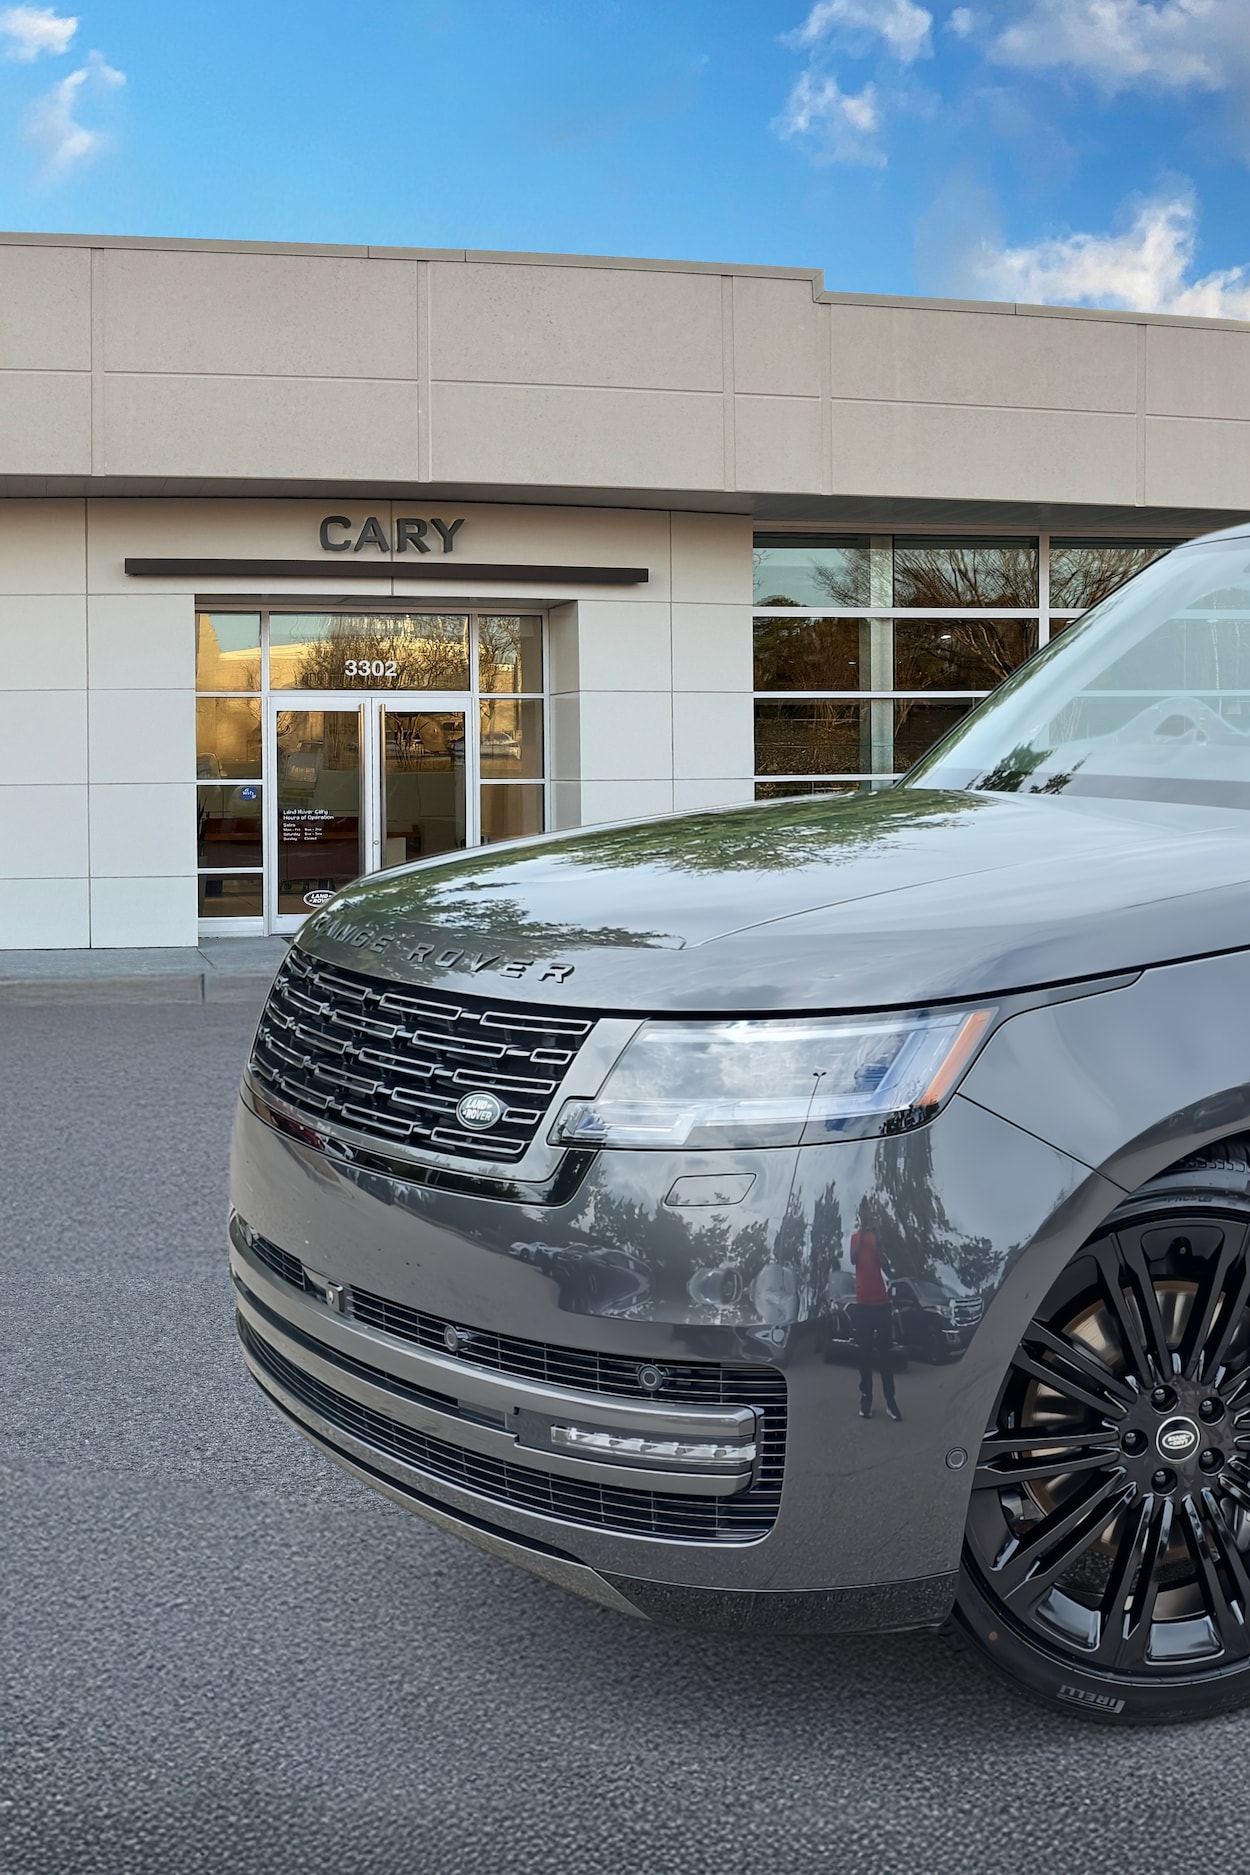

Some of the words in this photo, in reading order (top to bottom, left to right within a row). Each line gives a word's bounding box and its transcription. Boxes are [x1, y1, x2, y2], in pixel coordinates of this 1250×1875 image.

[319, 515, 466, 554] CARY
[344, 659, 398, 677] 3302
[312, 911, 397, 955] RANGE
[406, 942, 576, 984] ROVER
[464, 1108, 493, 1121] ROVER
[465, 1098, 489, 1110] LAND
[1056, 1684, 1126, 1714] PIRELLI
